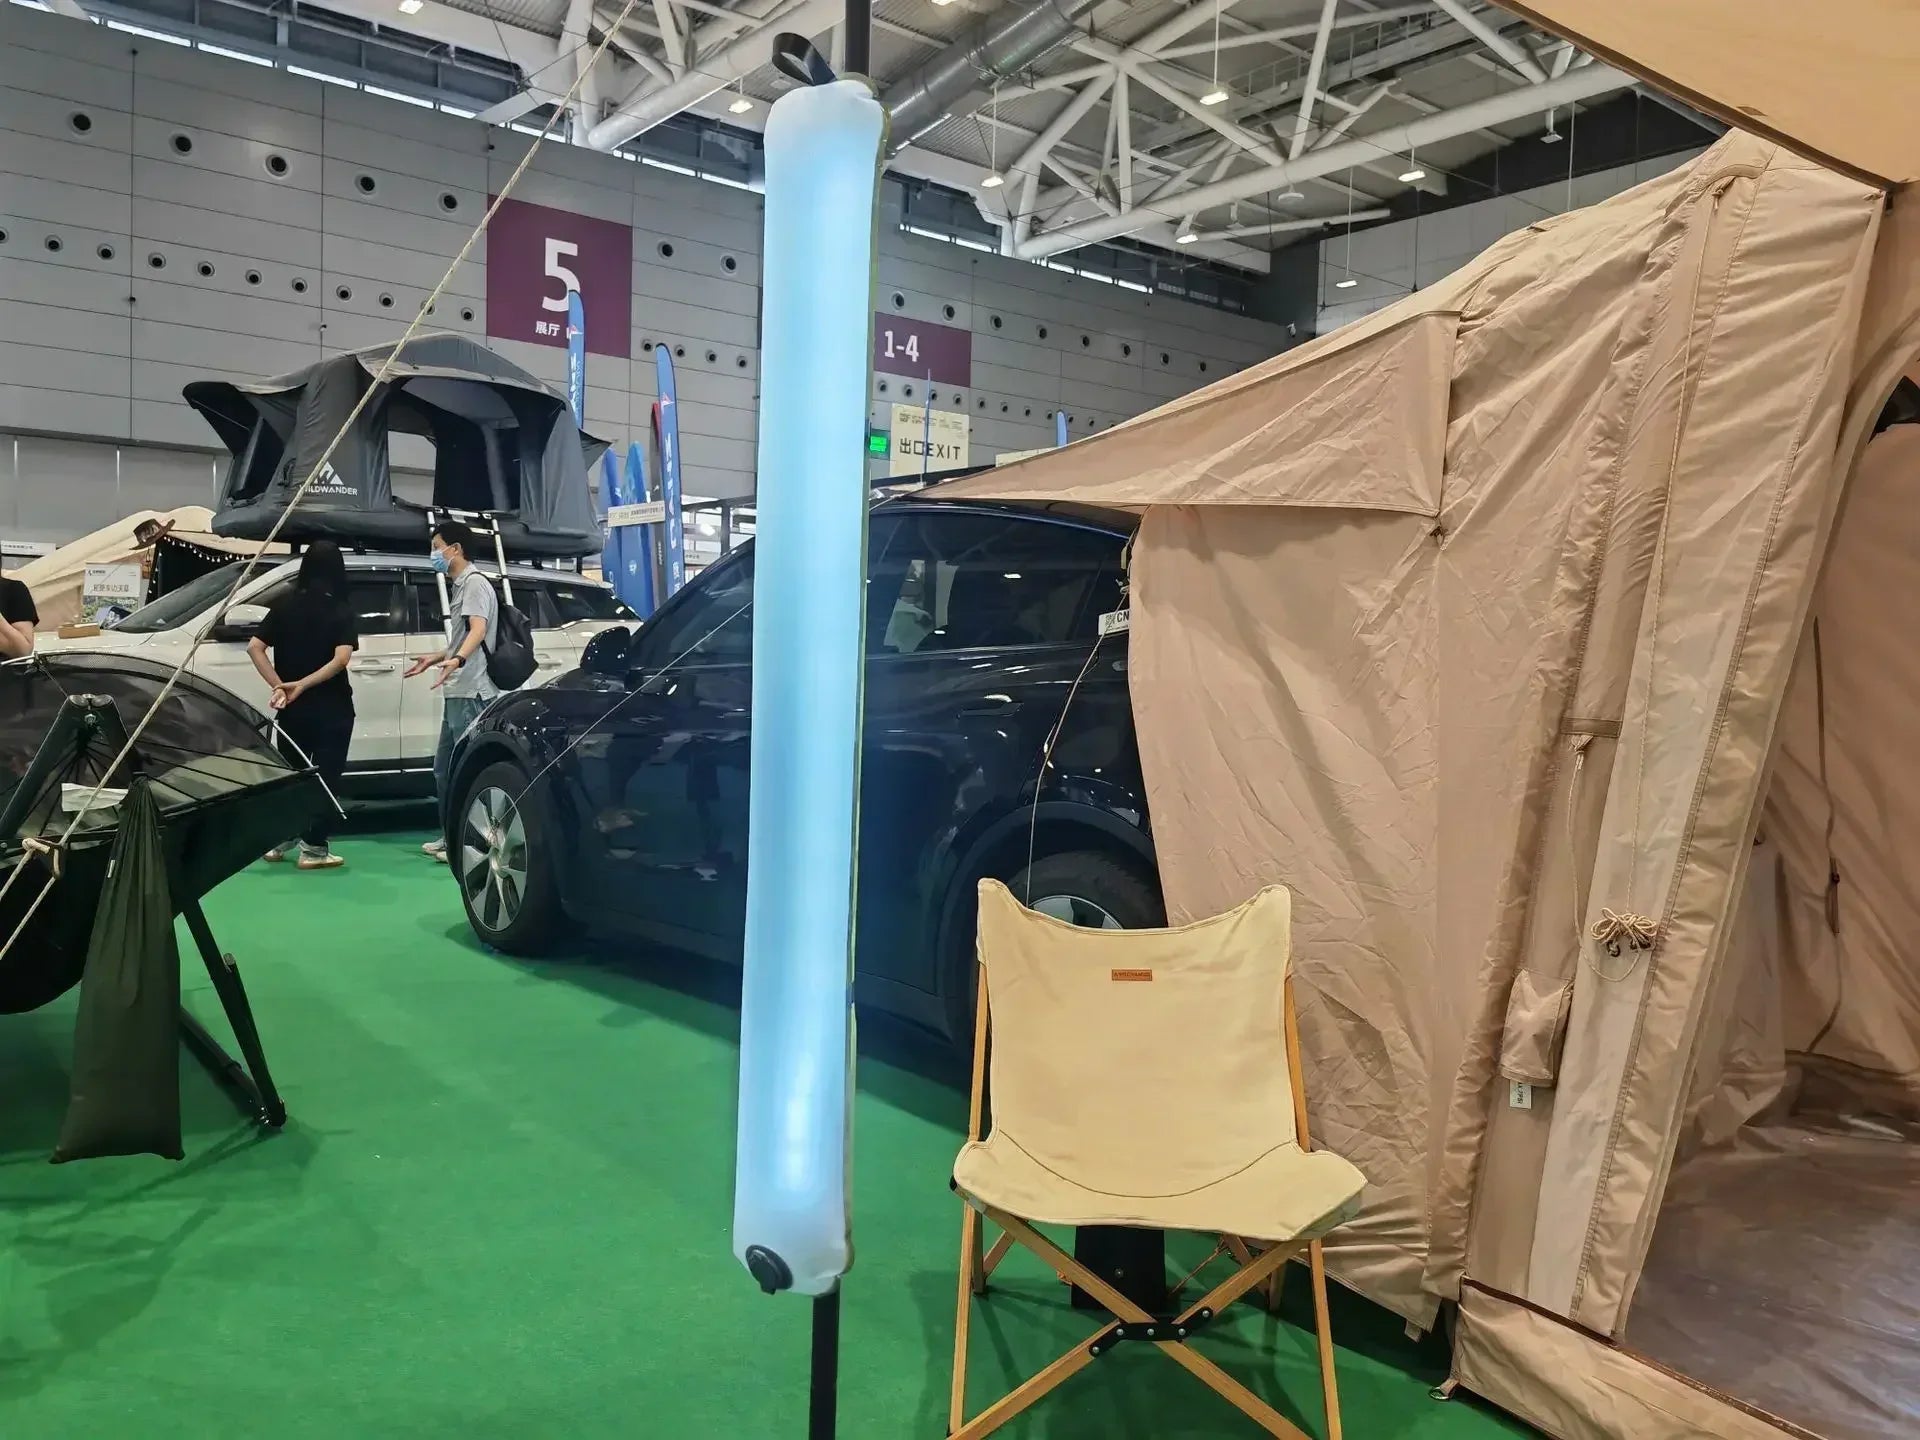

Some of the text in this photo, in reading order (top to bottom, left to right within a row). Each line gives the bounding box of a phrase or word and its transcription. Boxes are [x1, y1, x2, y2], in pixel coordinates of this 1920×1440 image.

[542, 238, 581, 312] 5
[536, 321, 561, 337] 展厅
[884, 330, 919, 362] 1-4
